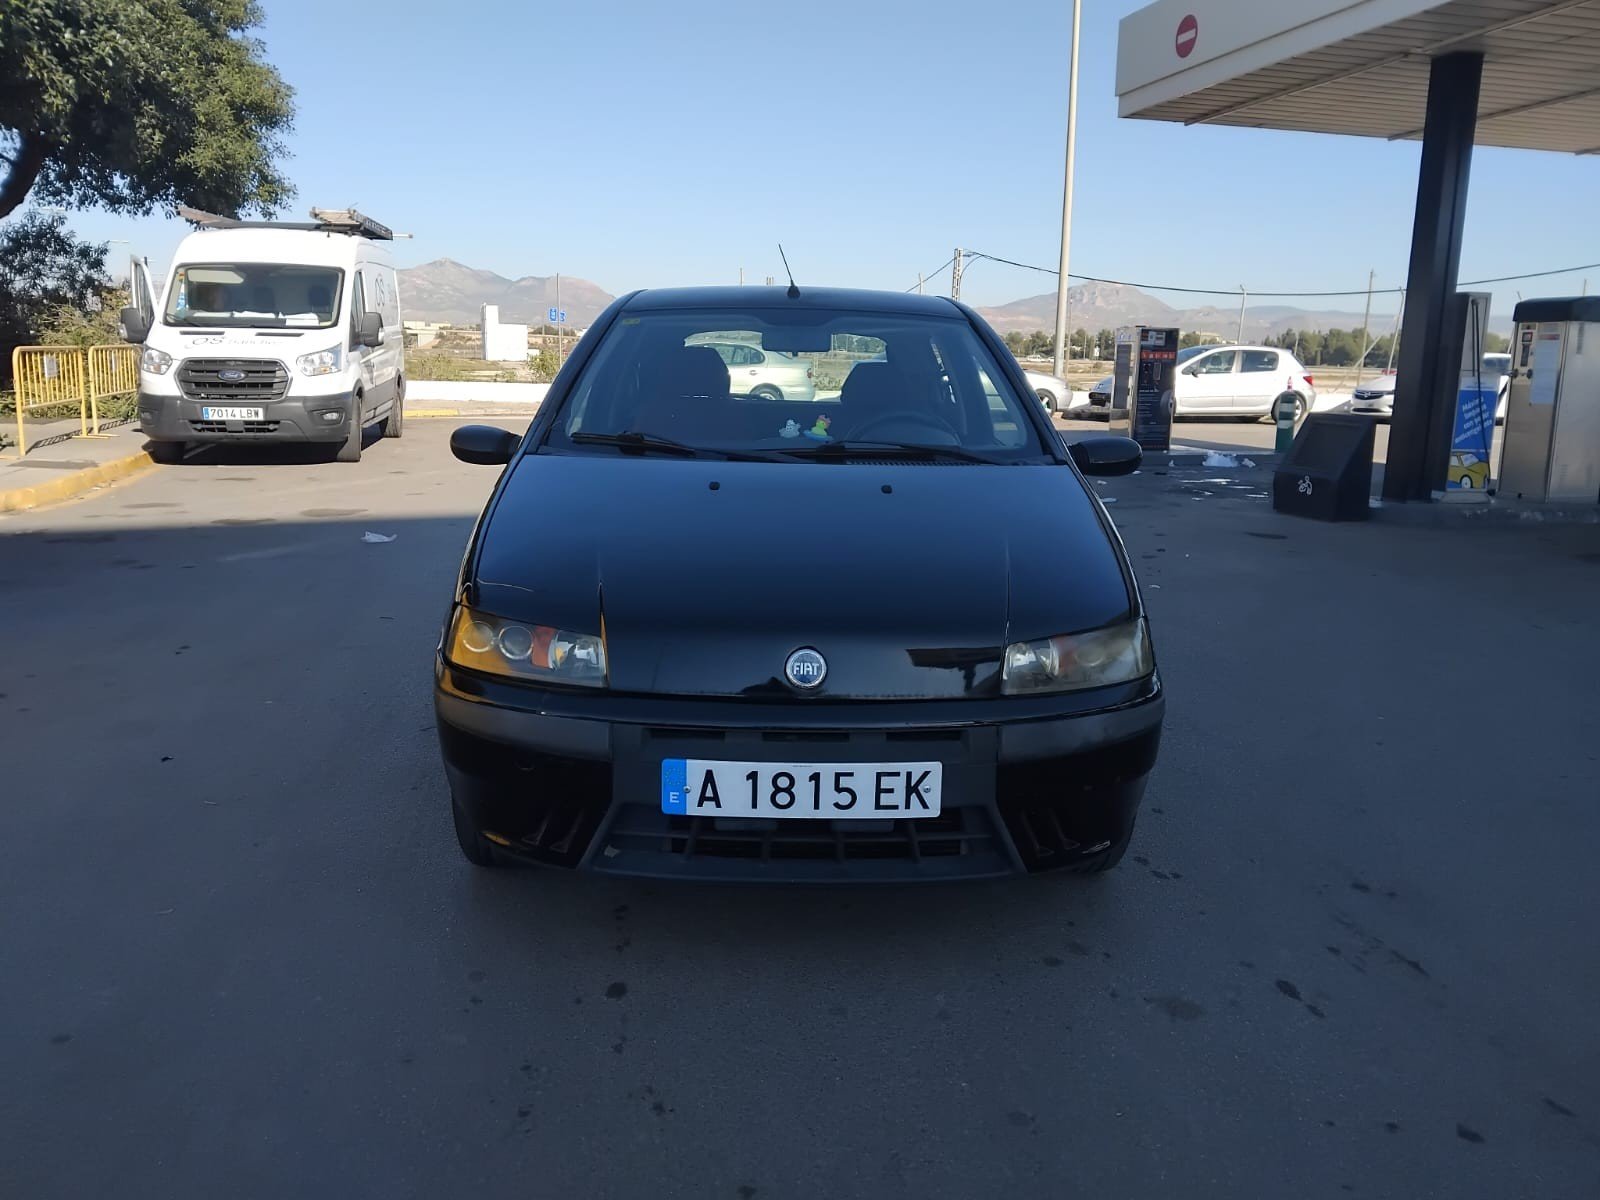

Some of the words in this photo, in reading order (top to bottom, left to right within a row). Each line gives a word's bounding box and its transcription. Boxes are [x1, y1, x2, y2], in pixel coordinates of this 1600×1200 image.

[210, 408, 236, 418] 7014
[239, 408, 260, 419] LBW
[792, 662, 820, 676] FIAT
[696, 768, 722, 809] A
[745, 770, 858, 811] 1815
[874, 770, 933, 811] EK
[669, 791, 680, 803] E
